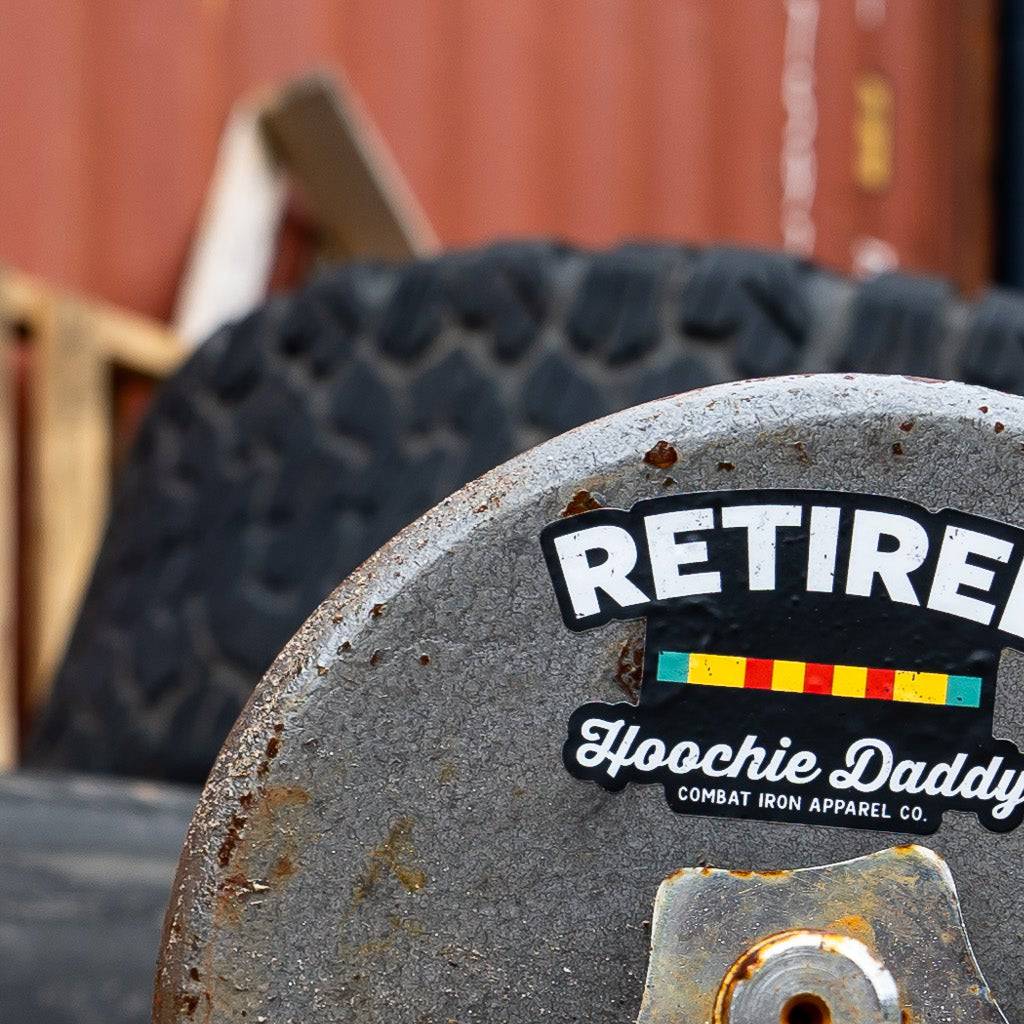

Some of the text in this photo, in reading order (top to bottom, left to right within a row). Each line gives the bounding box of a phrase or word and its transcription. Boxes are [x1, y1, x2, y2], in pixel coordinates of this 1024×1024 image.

[574, 717, 822, 785] Hoochie
[677, 785, 928, 823] COMBAT IRON APPAREL CO.
